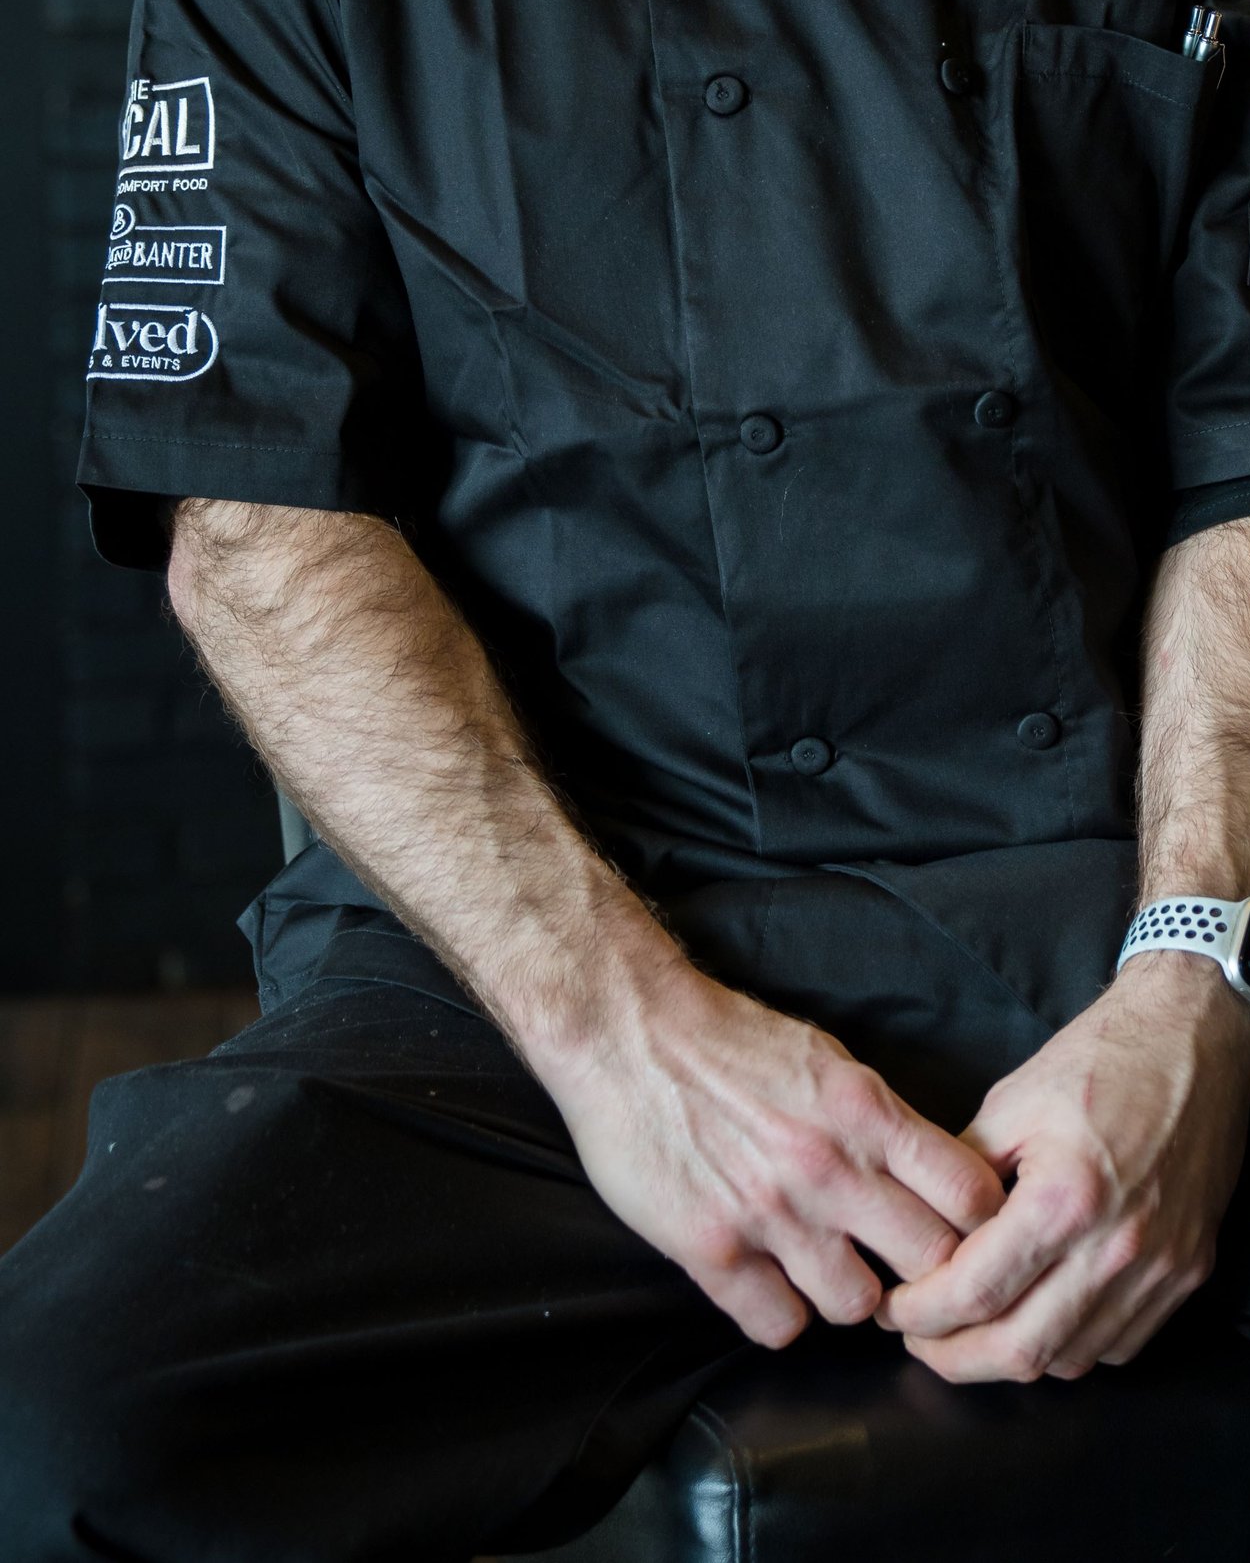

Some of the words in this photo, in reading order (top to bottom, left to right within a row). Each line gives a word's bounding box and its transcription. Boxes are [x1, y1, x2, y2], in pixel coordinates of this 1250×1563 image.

[122, 98, 200, 160] CAL
[117, 179, 169, 196] OMFORT
[172, 178, 208, 192] FOOD
[133, 241, 213, 270] BANTER
[92, 302, 199, 355] lved
[101, 354, 113, 368] &
[121, 354, 181, 371] EVENTS
